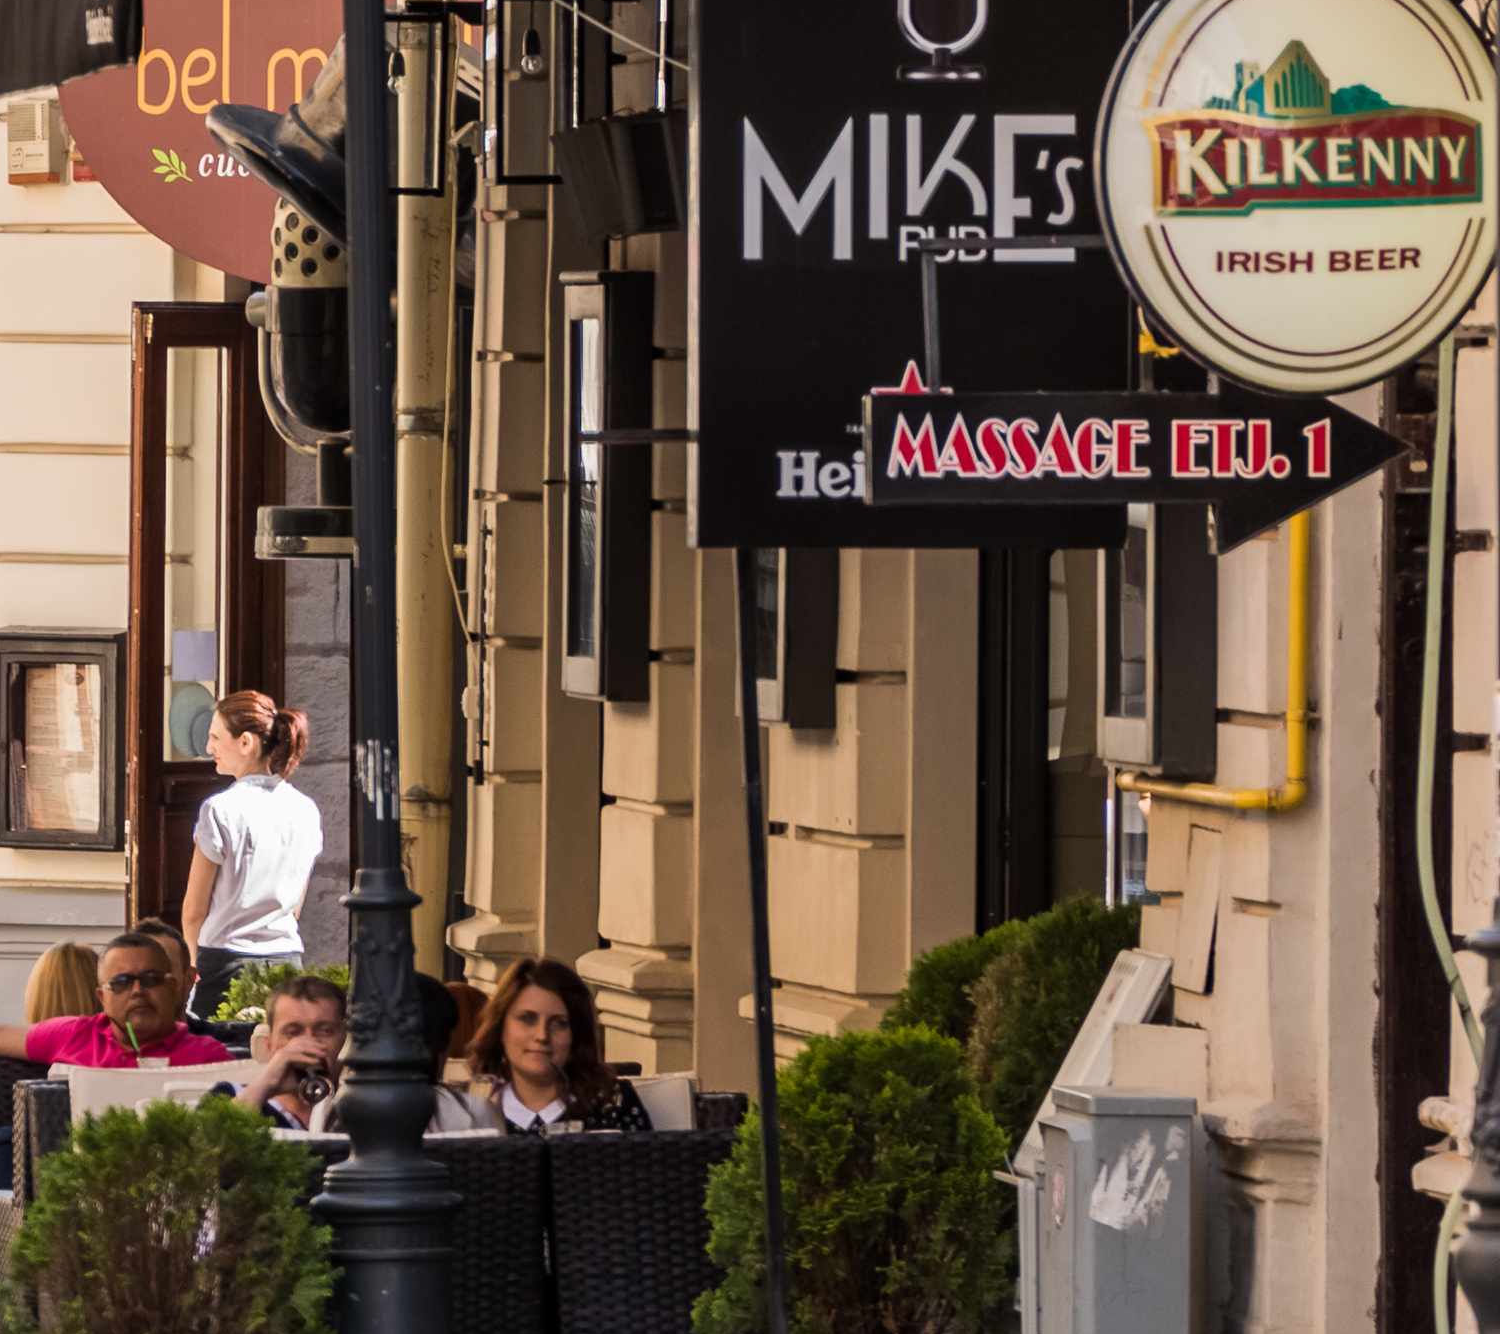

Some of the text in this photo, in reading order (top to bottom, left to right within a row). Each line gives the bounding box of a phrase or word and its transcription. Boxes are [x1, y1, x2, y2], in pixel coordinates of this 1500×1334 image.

[1173, 128, 1468, 196] KILKENNY
[1217, 248, 1422, 273] IRISH BEER
[886, 412, 1150, 479] MASSAGE
[1170, 418, 1292, 479] ETJ.
[1303, 417, 1332, 478] 1
